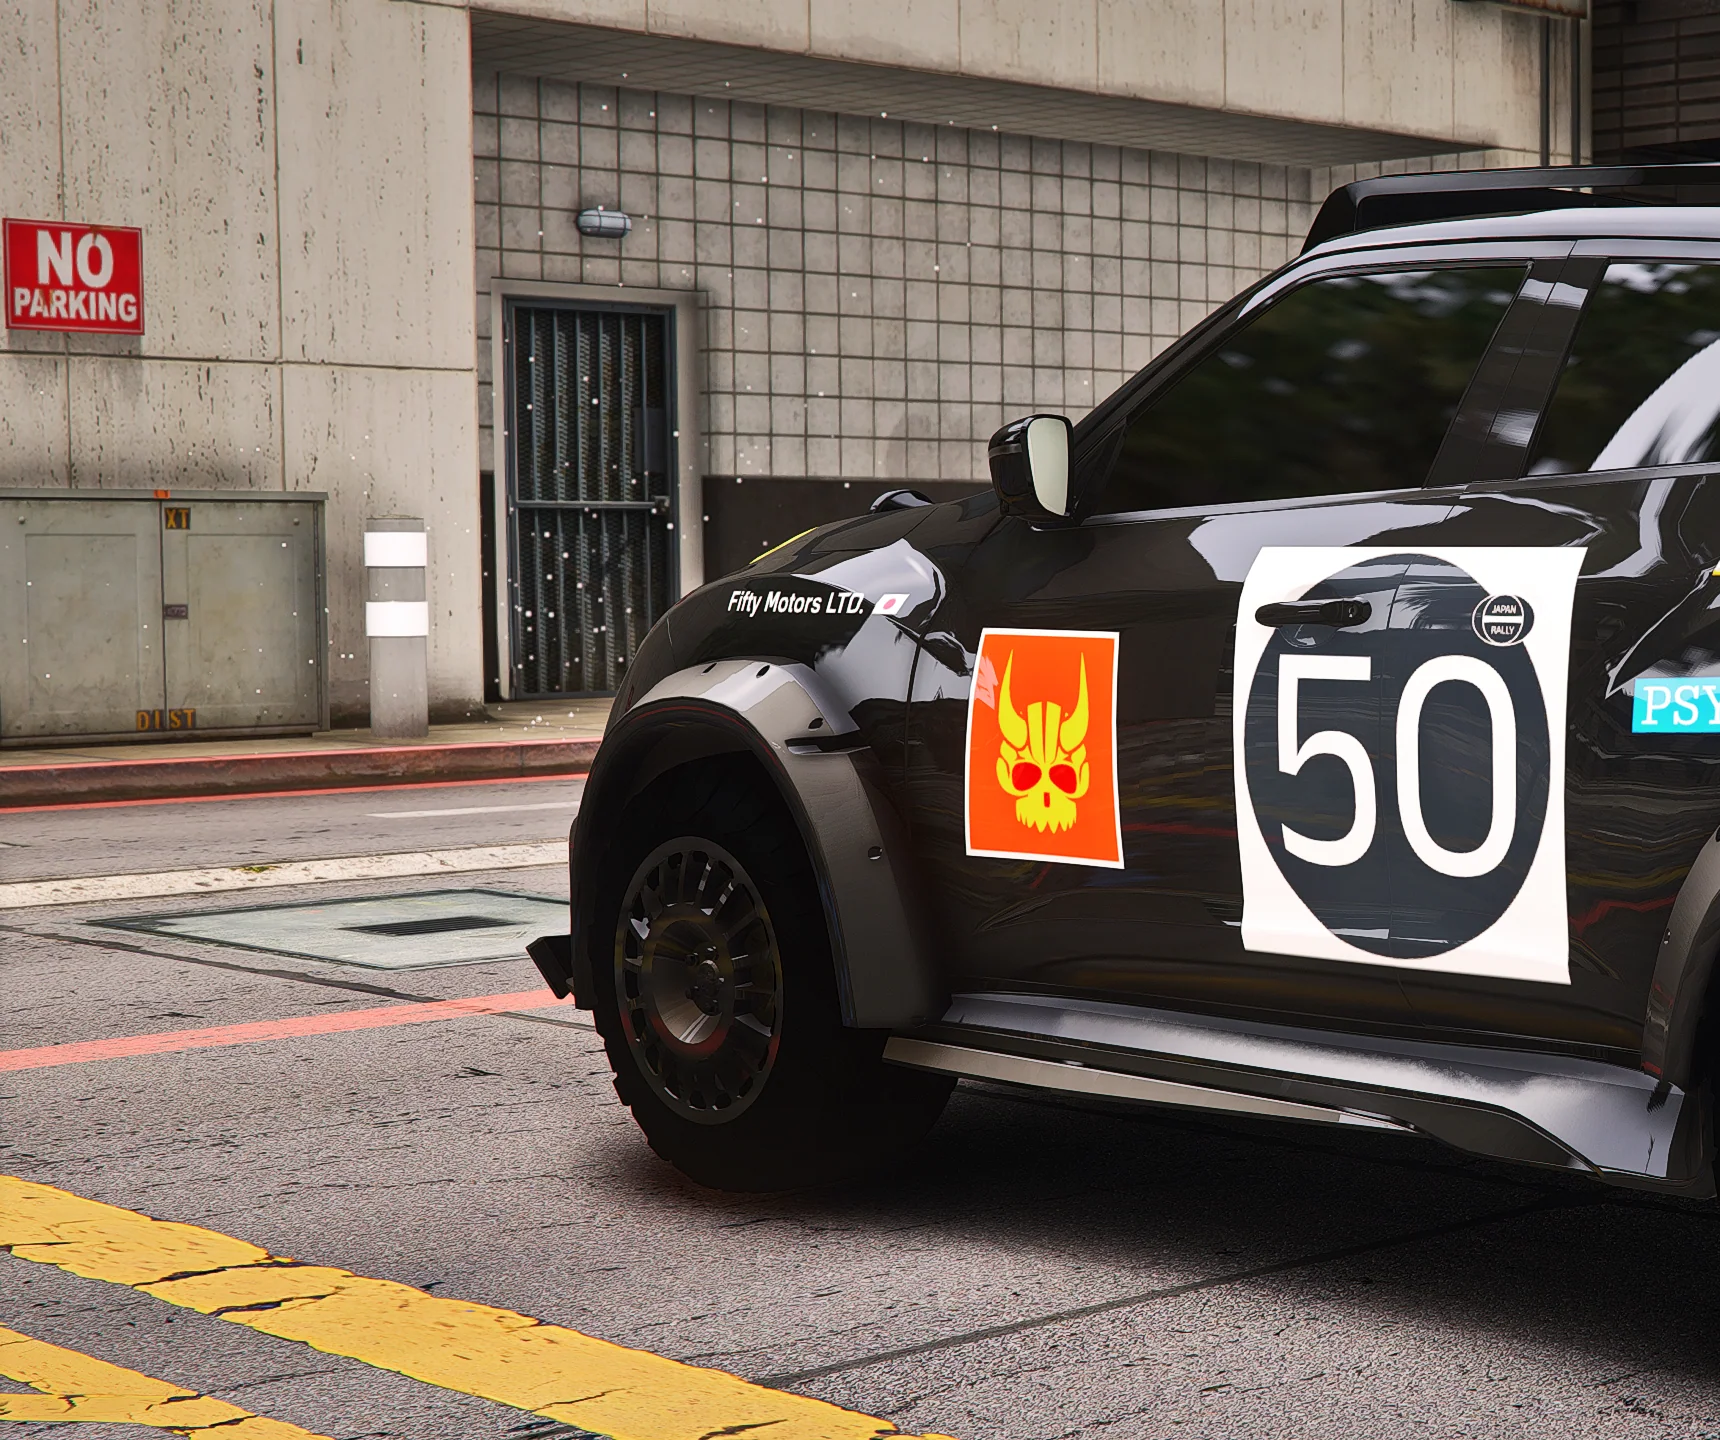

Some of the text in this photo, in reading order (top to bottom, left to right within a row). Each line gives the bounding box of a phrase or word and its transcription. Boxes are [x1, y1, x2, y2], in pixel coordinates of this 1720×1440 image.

[37, 229, 114, 289] NO
[14, 287, 137, 322] PARKING
[166, 509, 189, 529] XT
[727, 590, 865, 617] Fifty Motors LTD.
[1491, 604, 1517, 614] JAPAN
[1490, 625, 1515, 635] RALLY
[1278, 653, 1517, 878] 50
